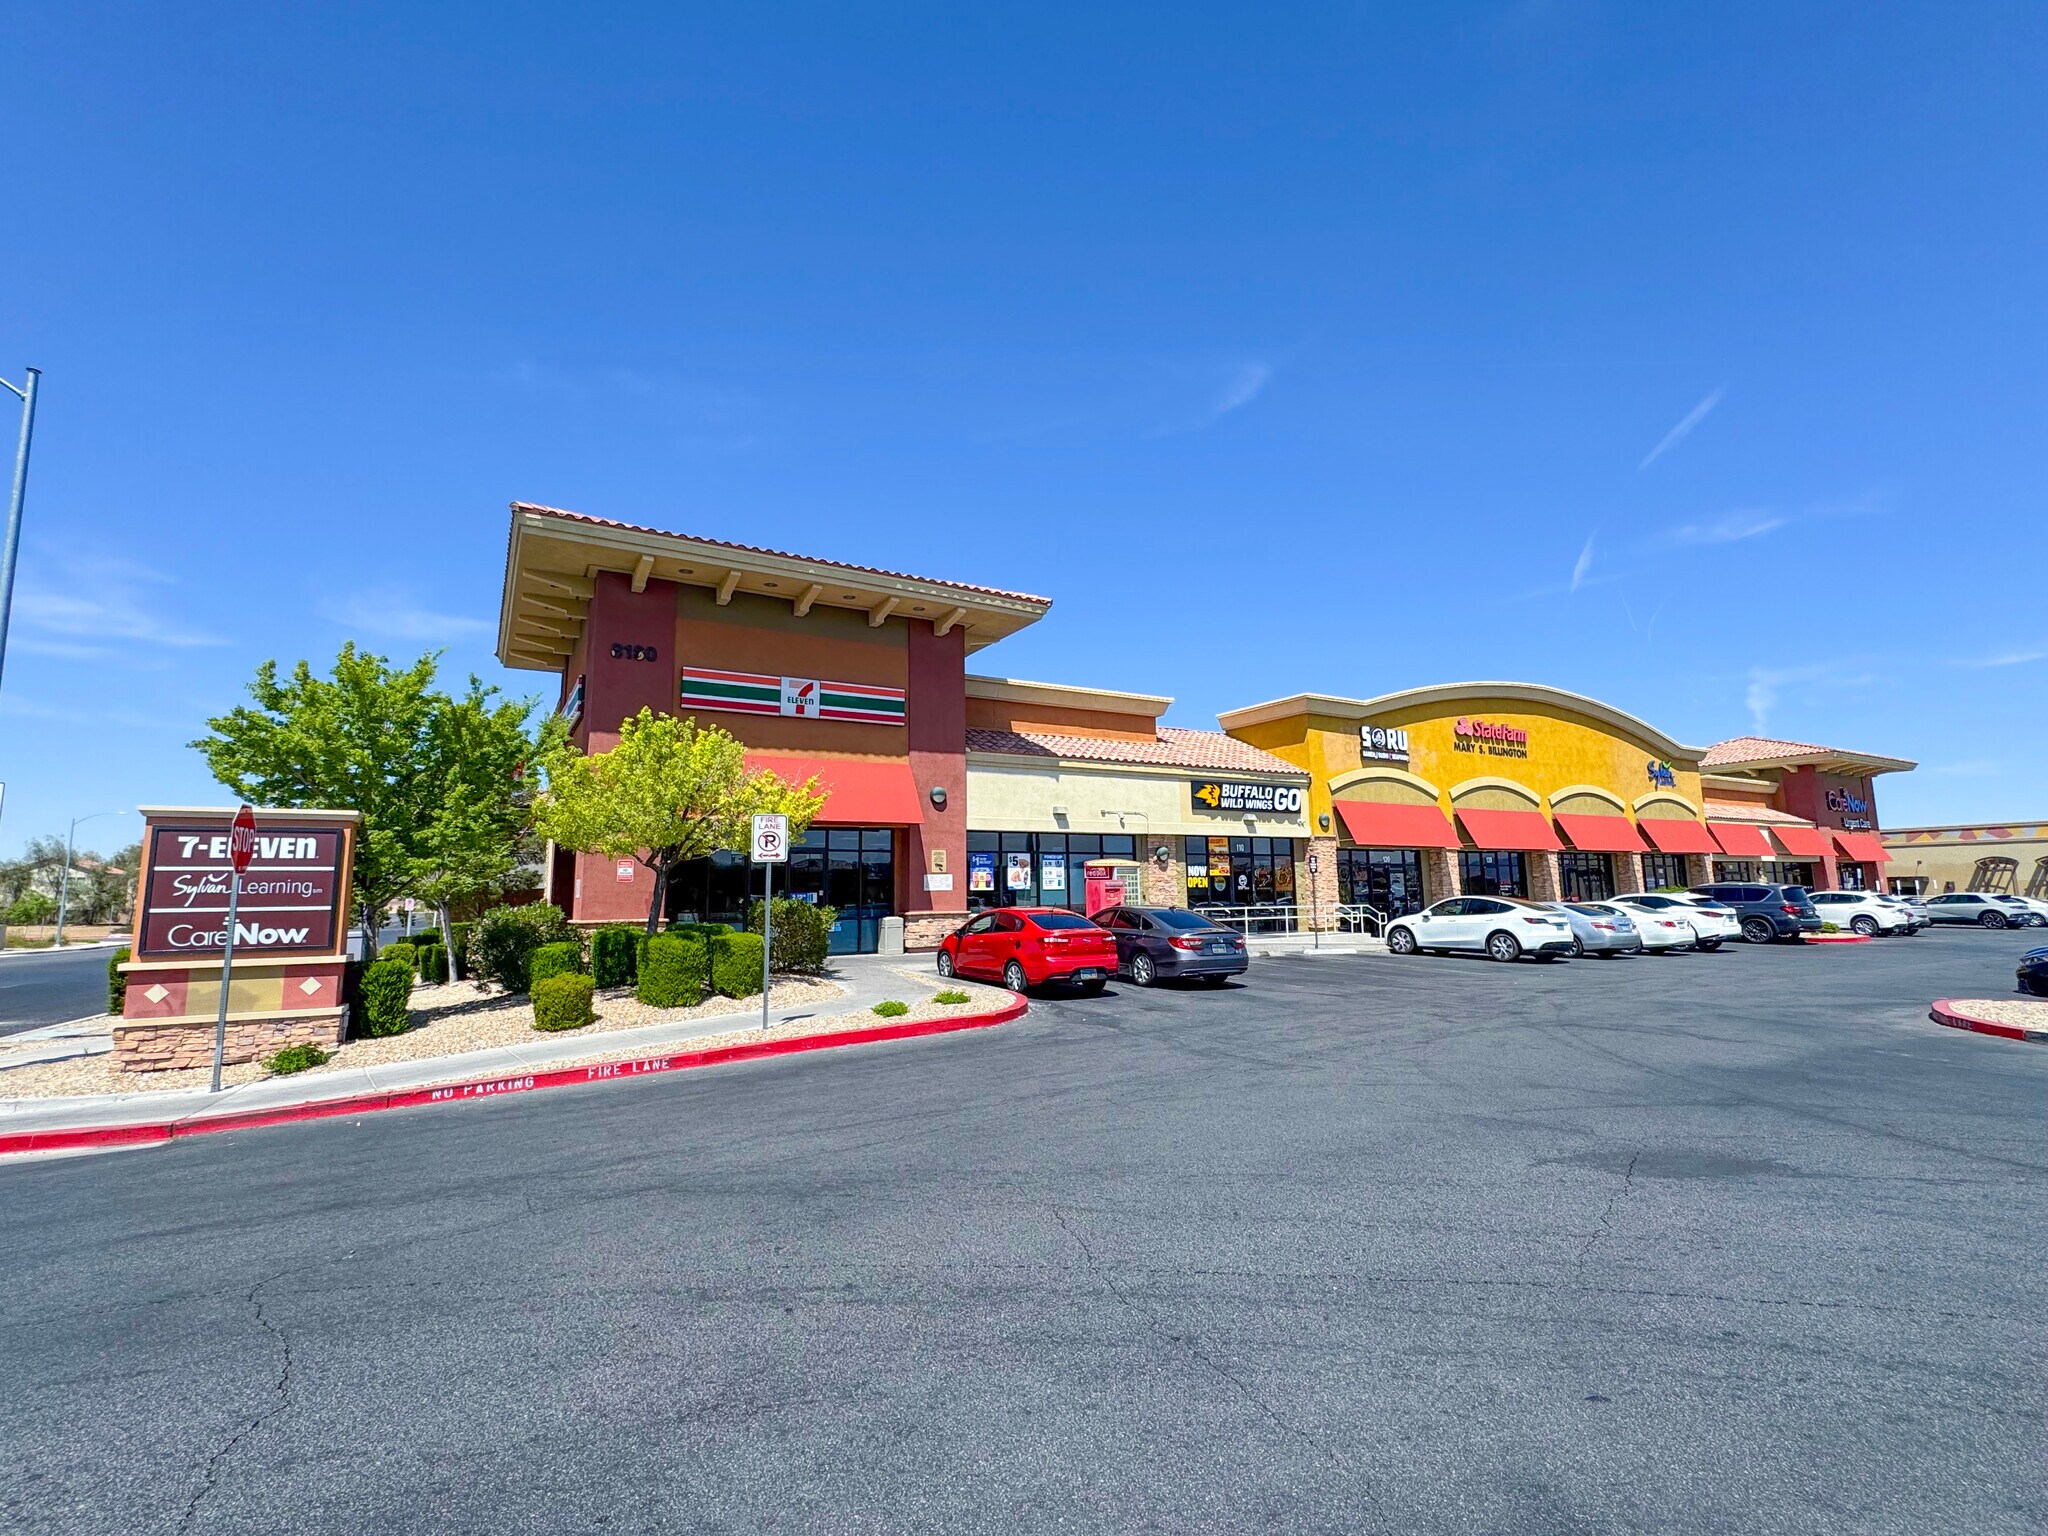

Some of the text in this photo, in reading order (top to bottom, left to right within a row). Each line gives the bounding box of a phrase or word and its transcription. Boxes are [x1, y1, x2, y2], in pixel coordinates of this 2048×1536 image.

[1361, 726, 1408, 751] SORU
[1454, 742, 1475, 753] MARY
[1488, 746, 1528, 759] BILLINGTON
[1221, 798, 1273, 810] WILD WINGS
[1222, 784, 1301, 811] BUFFALO GO
[232, 826, 255, 852] STOP
[1236, 844, 1244, 852] 110
[1009, 856, 1018, 866] $5
[1188, 866, 1207, 876] NOW
[173, 873, 232, 907] Sylvan
[238, 879, 313, 898] Learning
[1188, 877, 1208, 888] OPEN
[168, 922, 309, 947] CareNow
[464, 1076, 535, 1096] PARKING
[587, 1063, 623, 1079] FIRE
[632, 1058, 670, 1073] LANE
